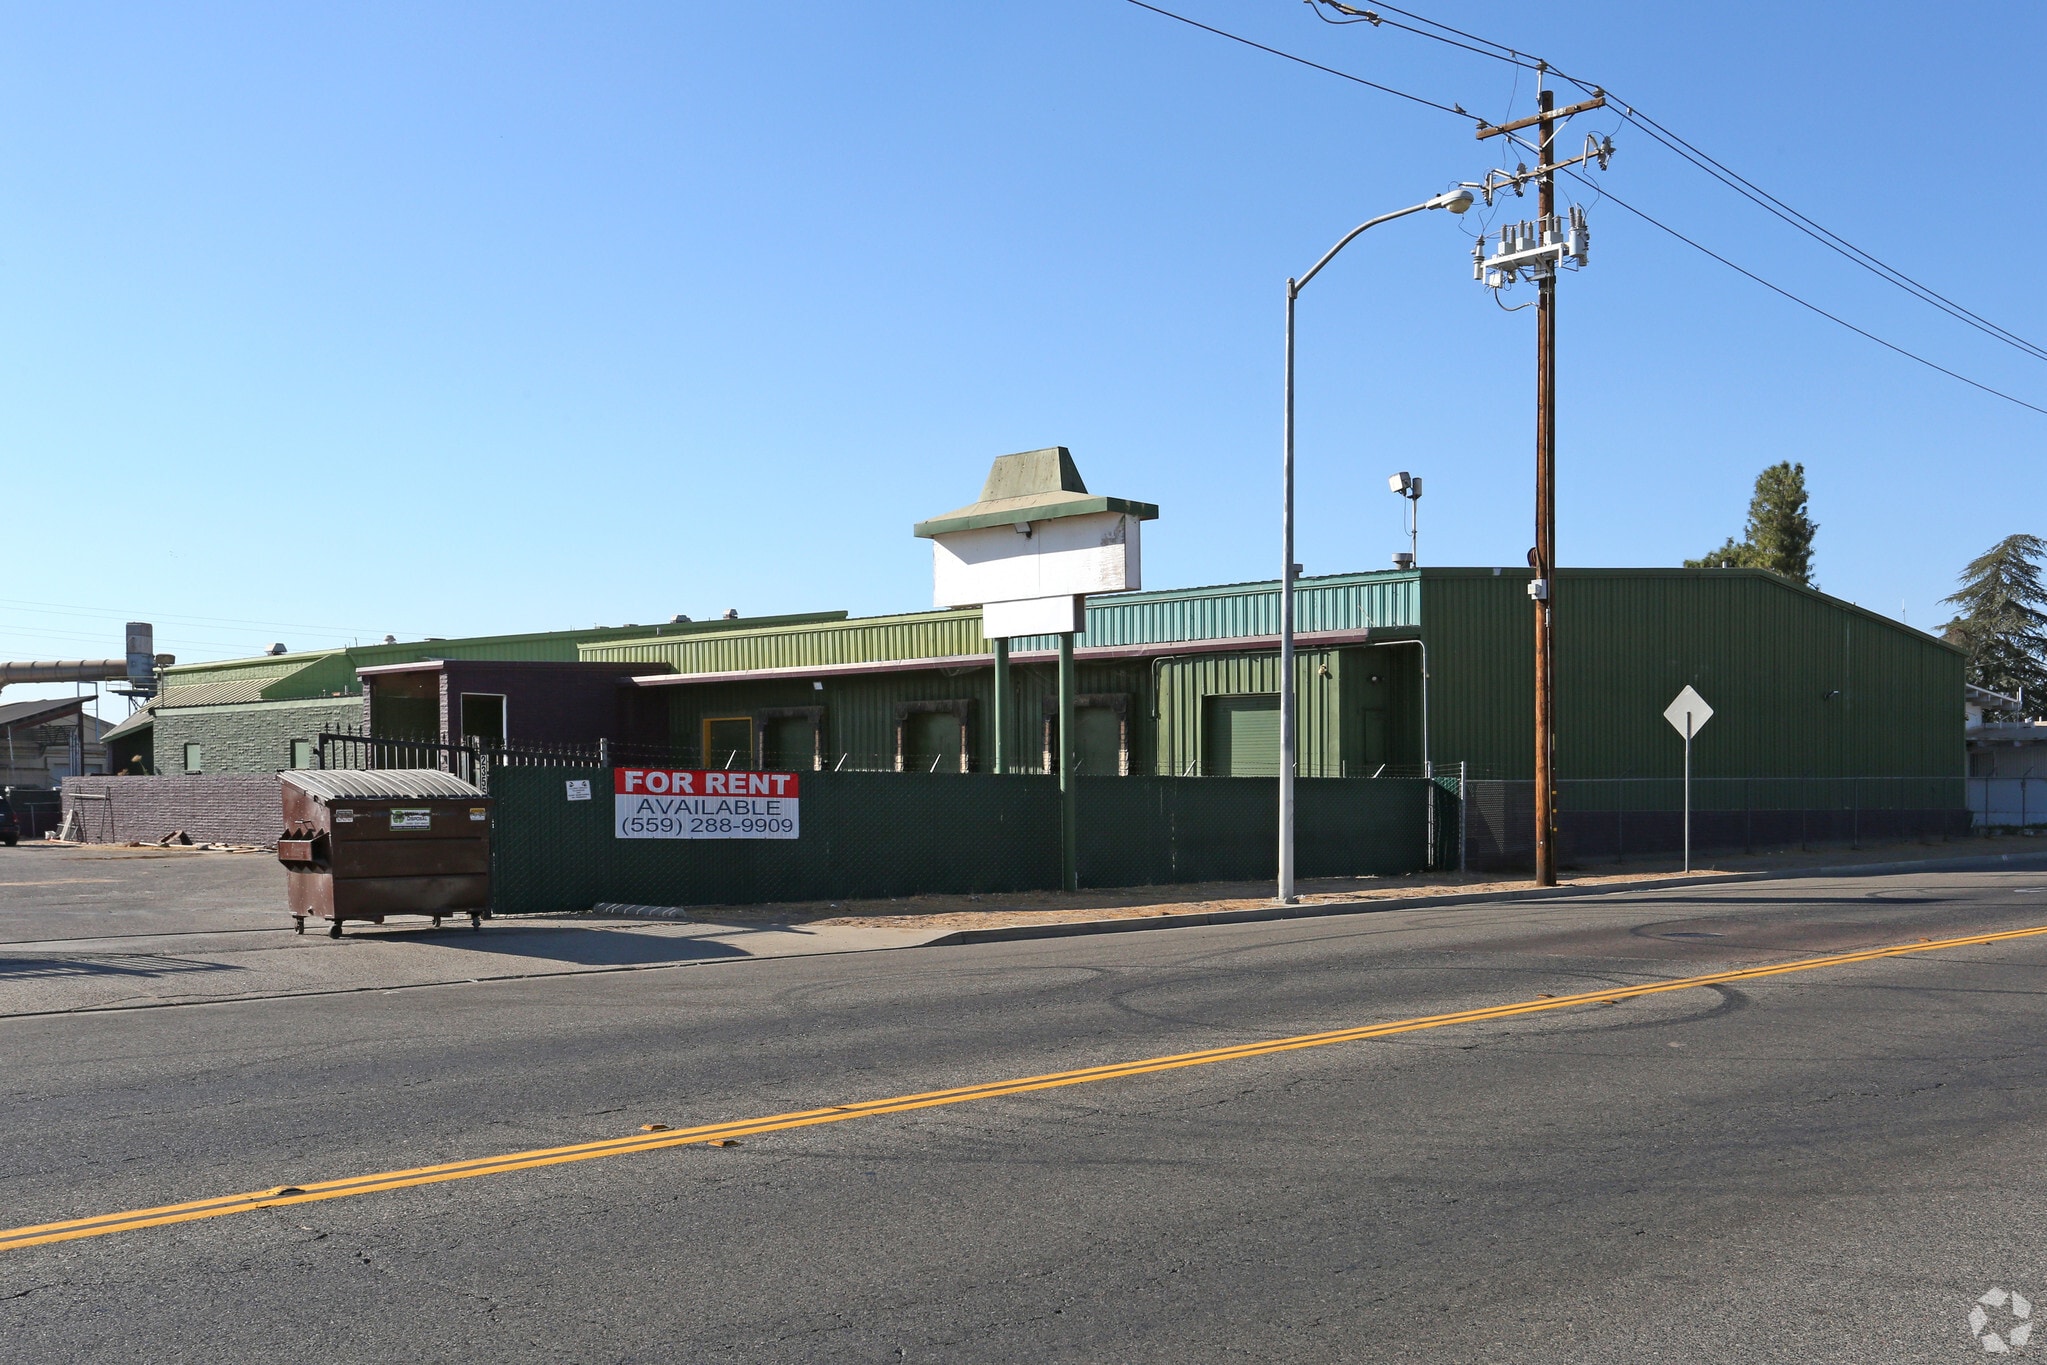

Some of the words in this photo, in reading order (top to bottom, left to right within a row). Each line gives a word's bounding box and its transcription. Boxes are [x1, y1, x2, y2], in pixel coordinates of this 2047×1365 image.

[625, 771, 694, 793] FOR
[705, 773, 791, 795] RENT
[637, 799, 781, 816] AVAILABLE
[622, 817, 682, 836] (559)
[690, 818, 793, 833] 288-9909
